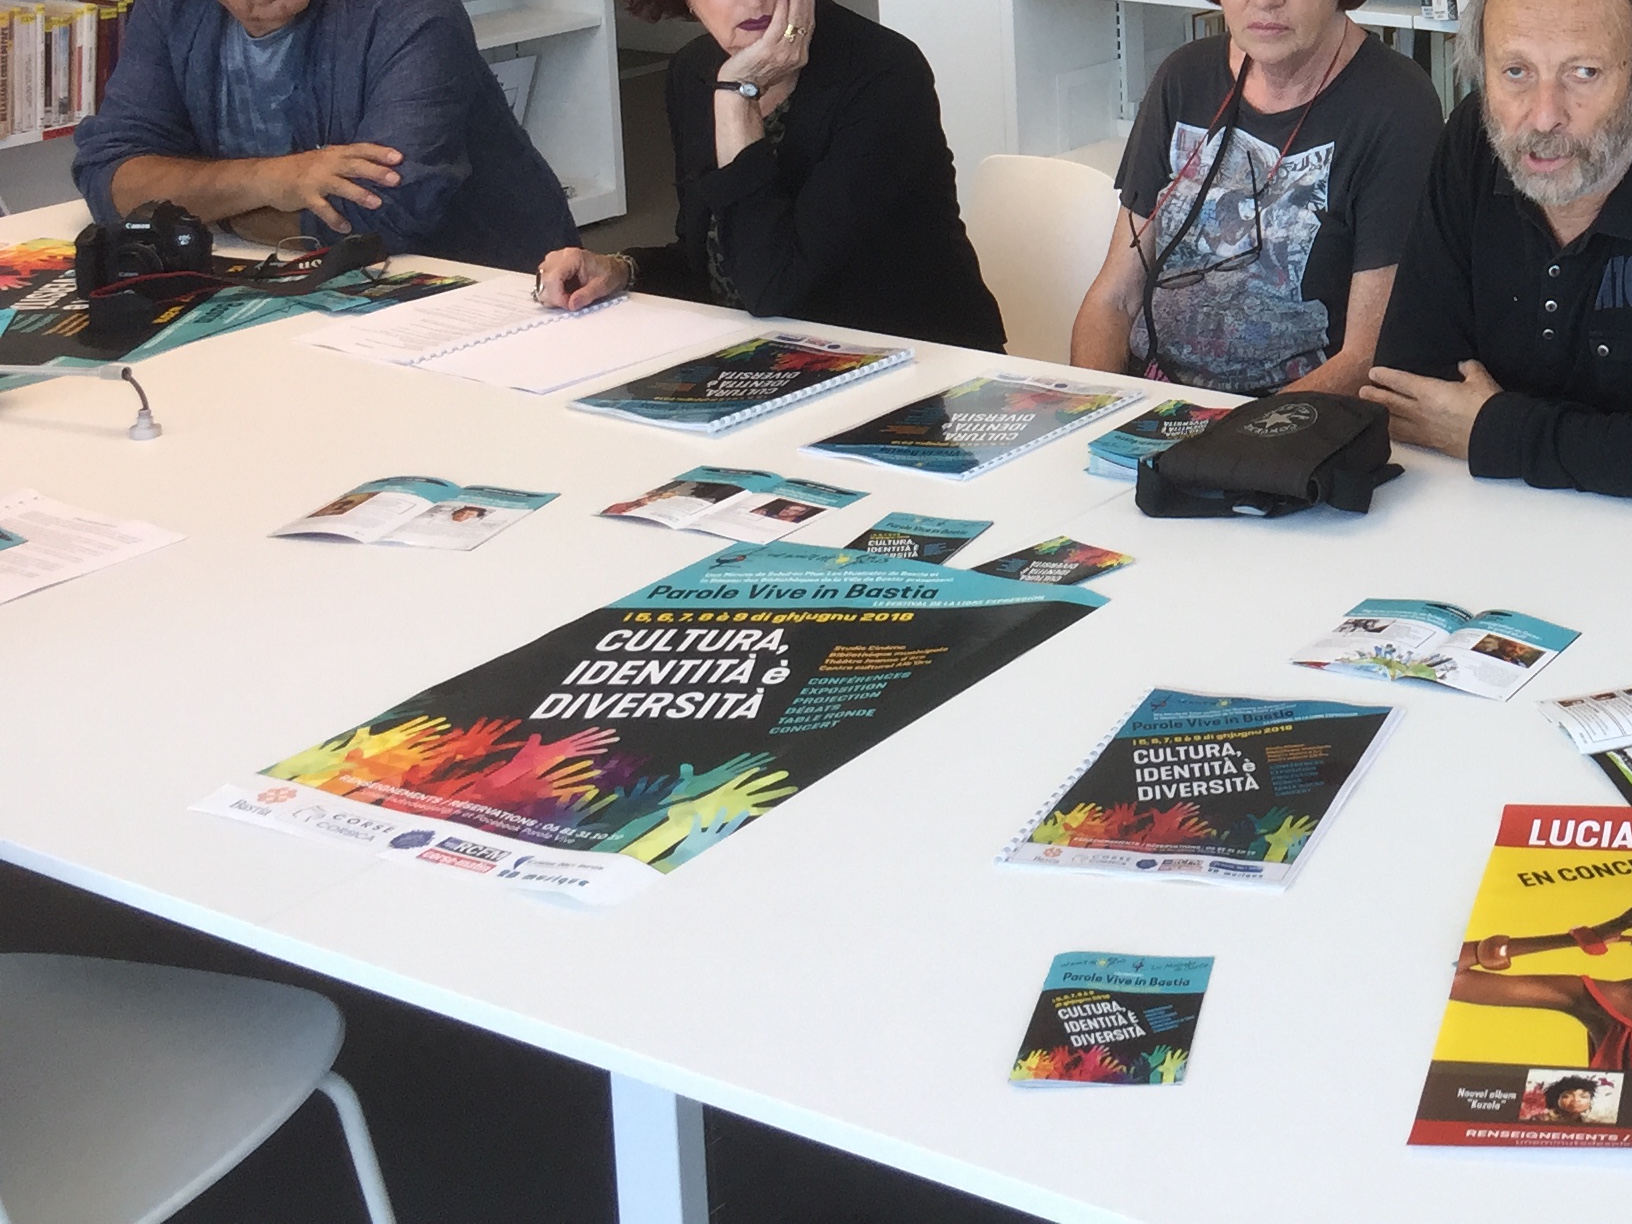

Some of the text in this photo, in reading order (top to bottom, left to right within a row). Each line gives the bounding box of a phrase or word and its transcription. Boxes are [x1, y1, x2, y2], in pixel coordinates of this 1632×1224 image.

[648, 583, 940, 600] Parole Vive in Bastia
[751, 612, 914, 624] di ghjugnu 2018
[596, 629, 789, 655] CULTURA,
[562, 654, 791, 685] IDENTITÀ è
[808, 671, 912, 685] CONFÉRENCES
[793, 691, 882, 704] PROJECTION
[800, 682, 888, 695] EXPOSITION
[529, 688, 764, 719] DIVERSITÀ
[785, 704, 841, 715] DÉBATS
[779, 709, 876, 724] TABLE RONDE
[769, 720, 840, 734] CONCERT
[1134, 742, 1242, 764] CULTURA,
[1135, 757, 1256, 782] IDENTITÀ è
[1137, 774, 1259, 801] DIVERSITÀ
[332, 813, 395, 833] CORSE
[455, 839, 508, 861] RCFM
[1518, 868, 1558, 887] EN
[1057, 1001, 1126, 1019] CULTURA,
[1064, 1013, 1127, 1033] IDENTITÀ
[1071, 1026, 1146, 1047] DIVERSITÀ
[1466, 1128, 1618, 1142] RENSEIGNEMENTS
